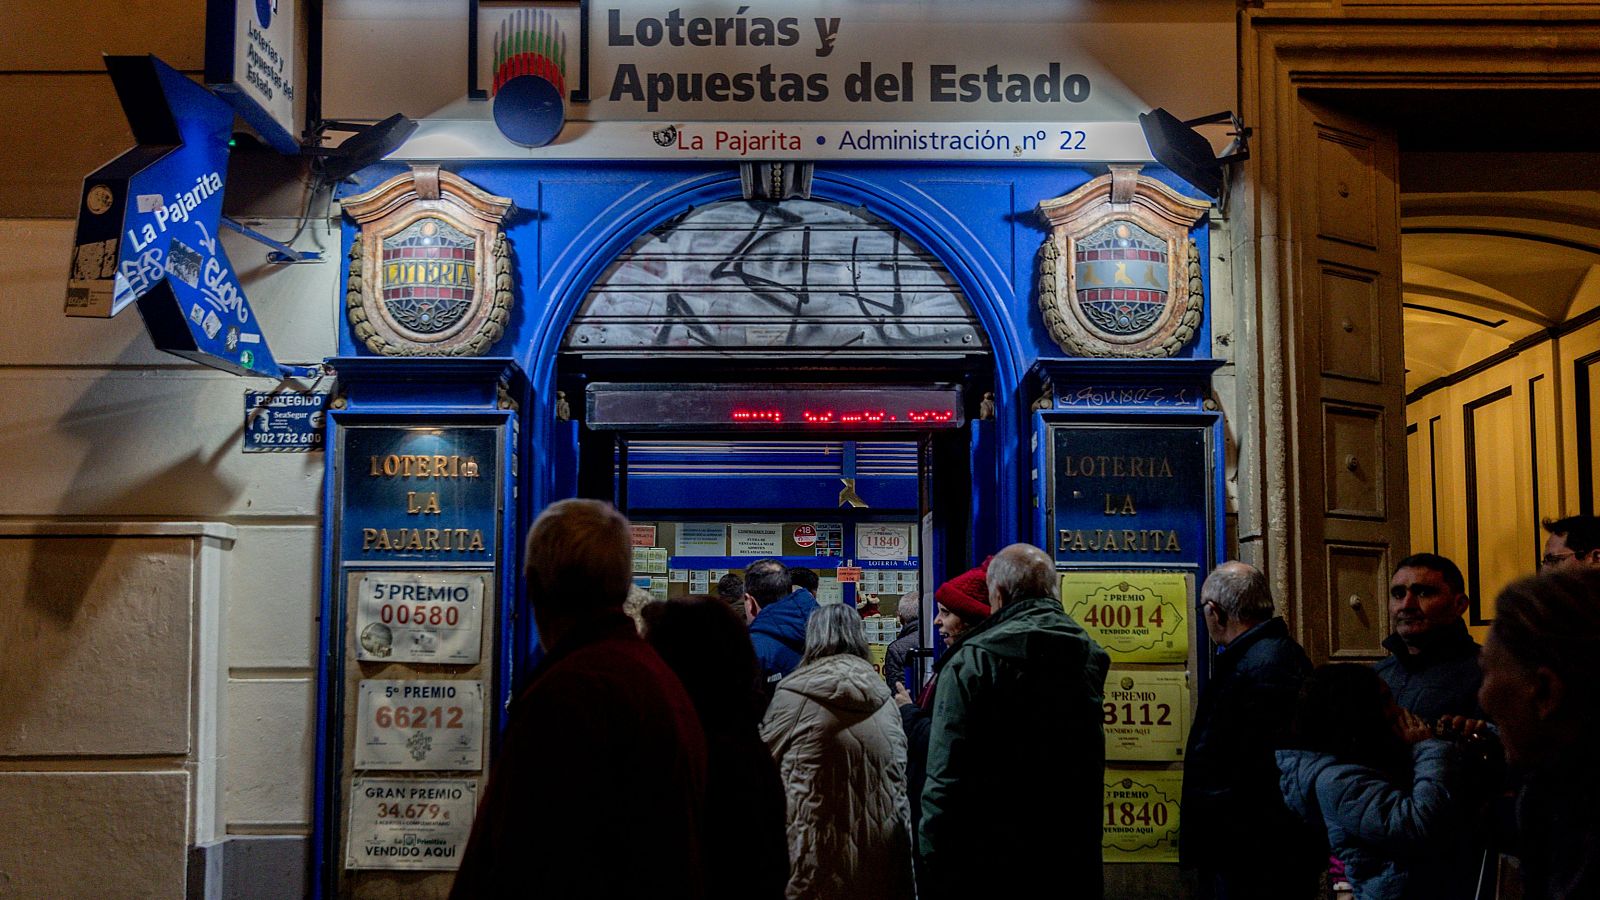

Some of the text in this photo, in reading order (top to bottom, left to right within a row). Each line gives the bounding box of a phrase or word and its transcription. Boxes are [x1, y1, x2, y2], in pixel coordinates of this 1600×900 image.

[608, 6, 841, 57] Loterías y
[246, 62, 273, 101] Estado
[247, 43, 294, 101] Apuestas del
[609, 62, 1091, 112] Apuestas del Estado
[678, 131, 703, 150] La
[716, 130, 801, 156] Pajarita
[839, 129, 1010, 151] Administración
[1059, 130, 1086, 151] 22
[128, 171, 224, 253] La Pajarita
[384, 261, 471, 287] LOTERIA
[255, 395, 321, 407] PROTEGIDO
[273, 411, 308, 420] SeaSegur
[253, 432, 321, 443] 902 732 600
[1065, 456, 1174, 478] LOTERIA
[407, 491, 442, 515] LA
[1104, 493, 1137, 515] LA
[362, 528, 486, 552] PAJARITA
[866, 536, 900, 547] 11840
[1059, 529, 1182, 551] PAJARITA
[389, 584, 469, 602] PREMIO
[1110, 593, 1145, 602] PREMIO
[381, 604, 459, 626] 00580
[1084, 604, 1164, 628] 40014
[385, 686, 456, 699] 5º PREMIO
[375, 705, 464, 729] 66212
[365, 787, 462, 800] GRAN PREMIO
[1113, 791, 1149, 800] PREMIO
[1104, 801, 1168, 827] 1840
[365, 844, 456, 857] VENDIDO AQUÍ
